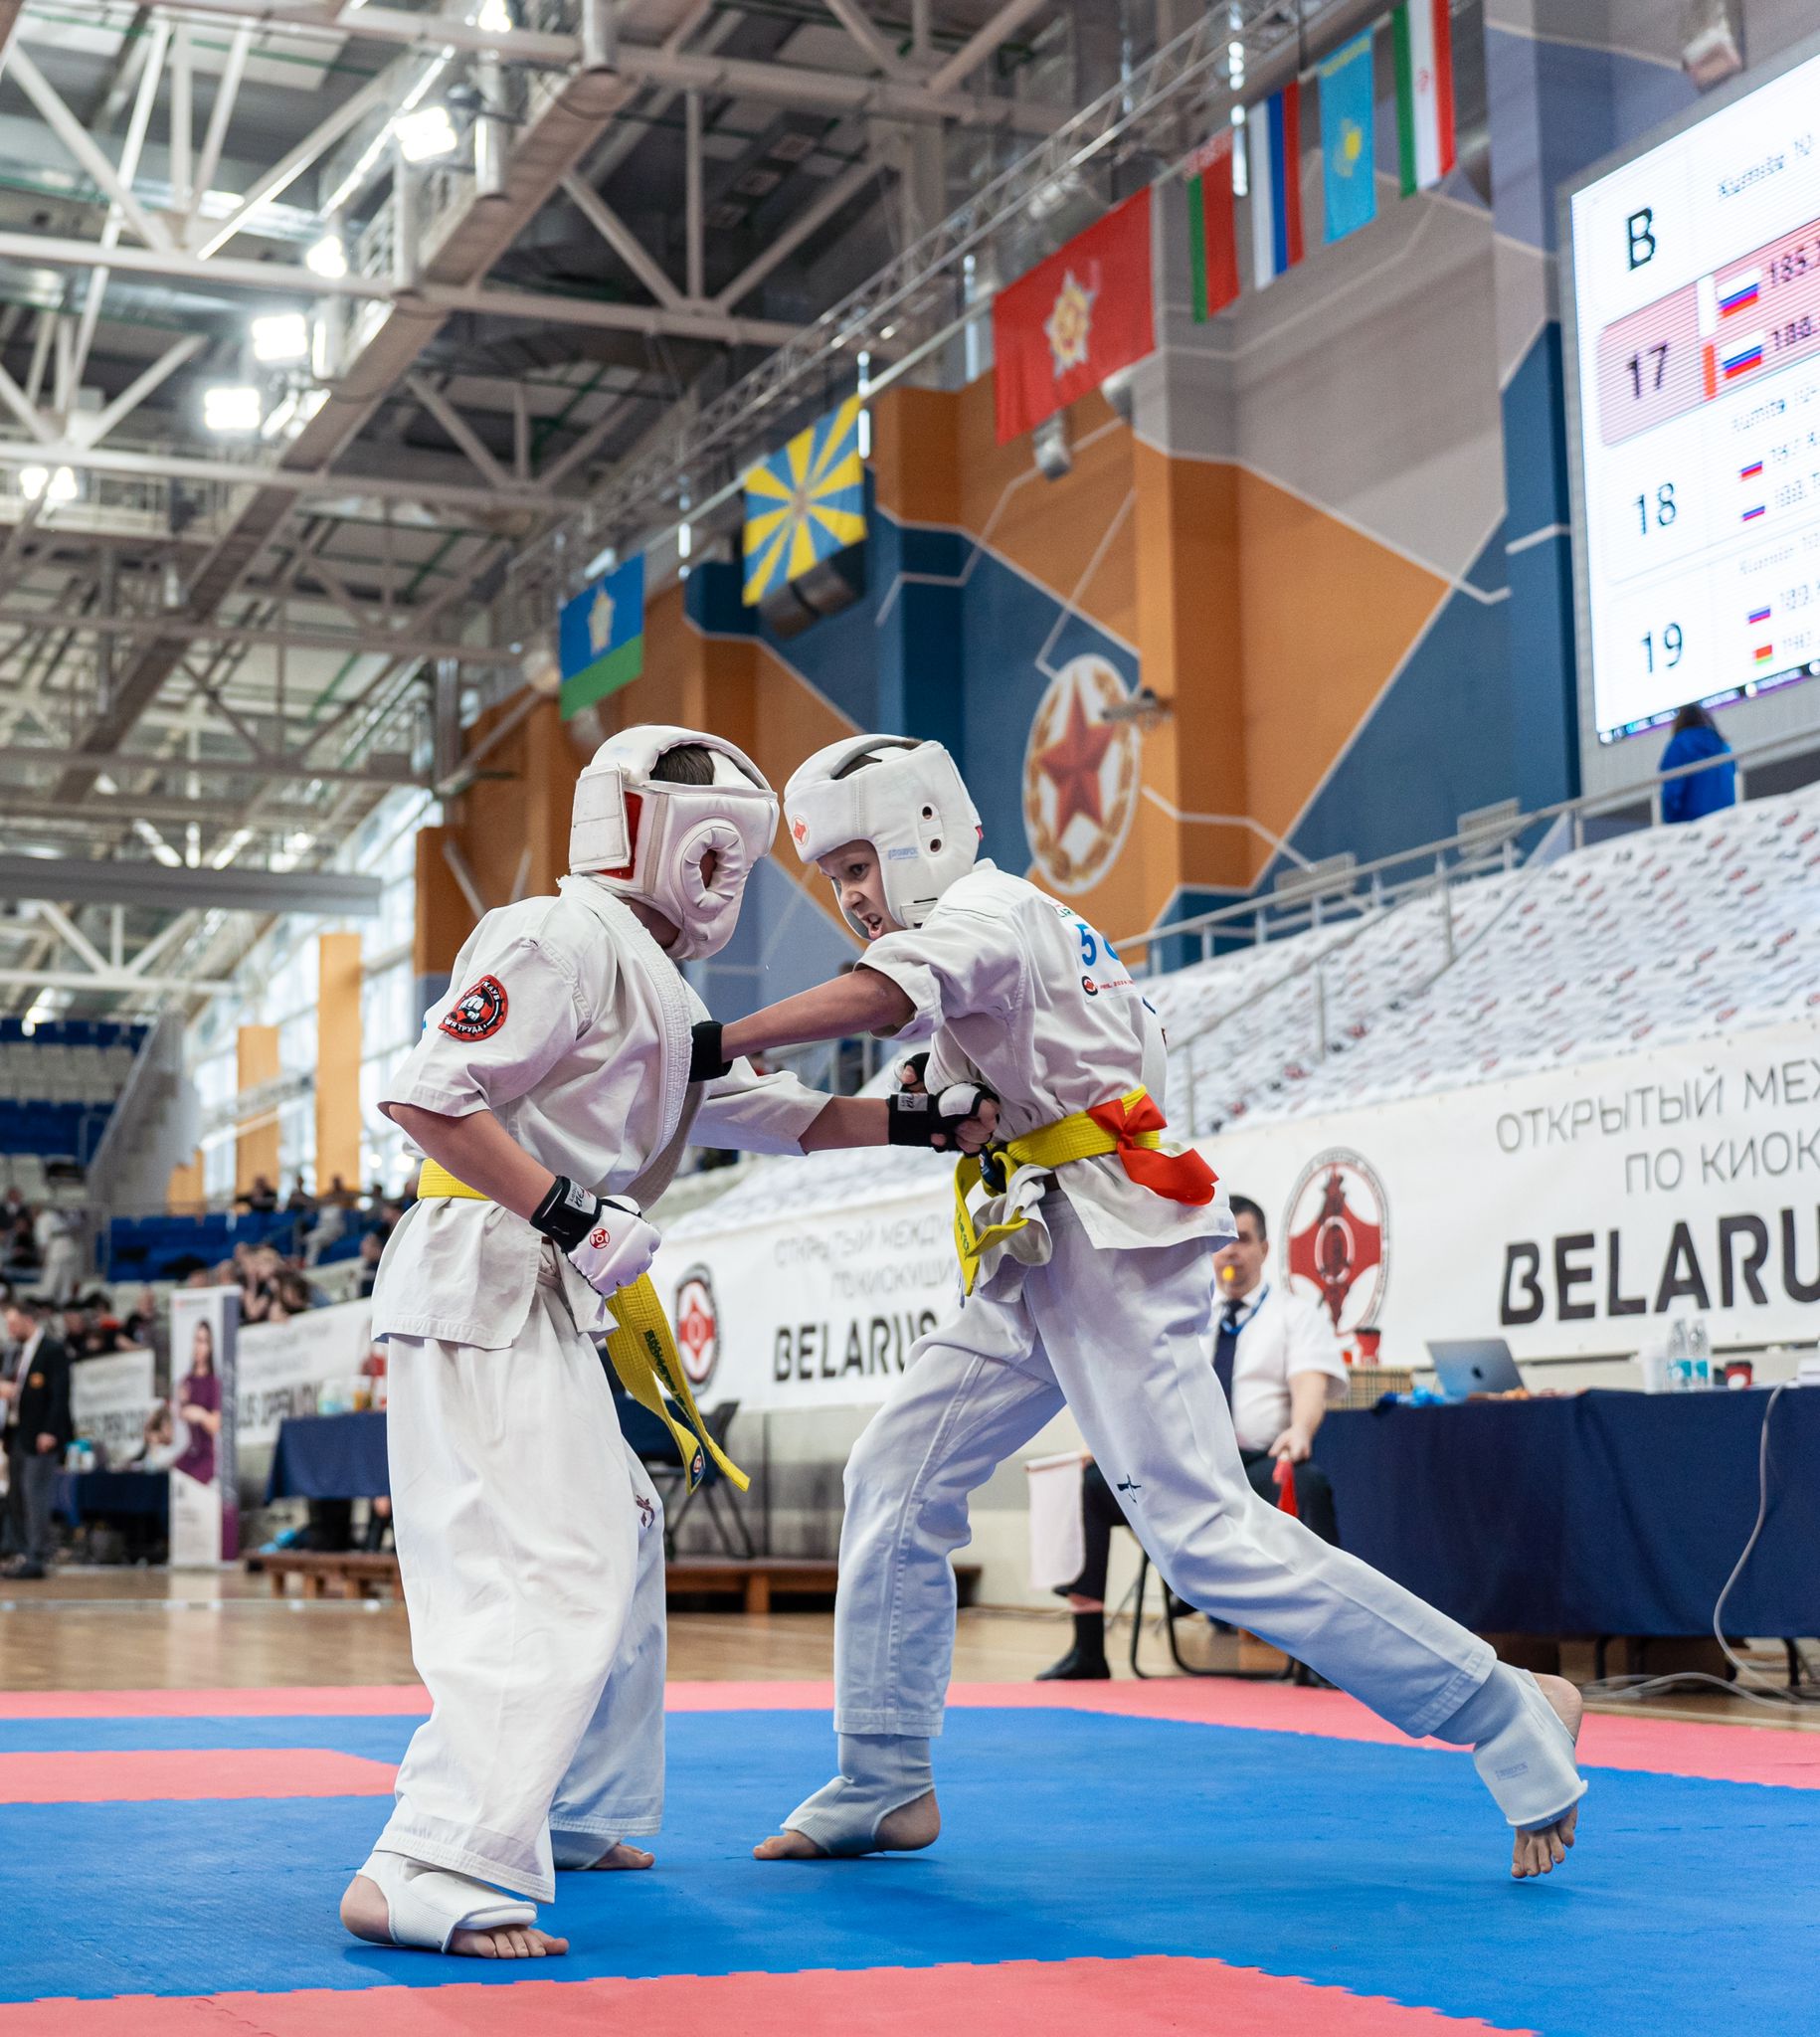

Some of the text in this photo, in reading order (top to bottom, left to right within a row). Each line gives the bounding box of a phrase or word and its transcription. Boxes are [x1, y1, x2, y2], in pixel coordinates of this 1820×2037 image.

[1627, 206, 1657, 272] B
[1627, 340, 1668, 400] 17
[1635, 481, 1677, 536] 18
[1641, 622, 1684, 674] 19
[457, 1022, 483, 1034] ТРУДА
[1495, 1064, 1724, 1154] ОТКРЫТЫЙ
[1625, 1147, 1683, 1194] ПО
